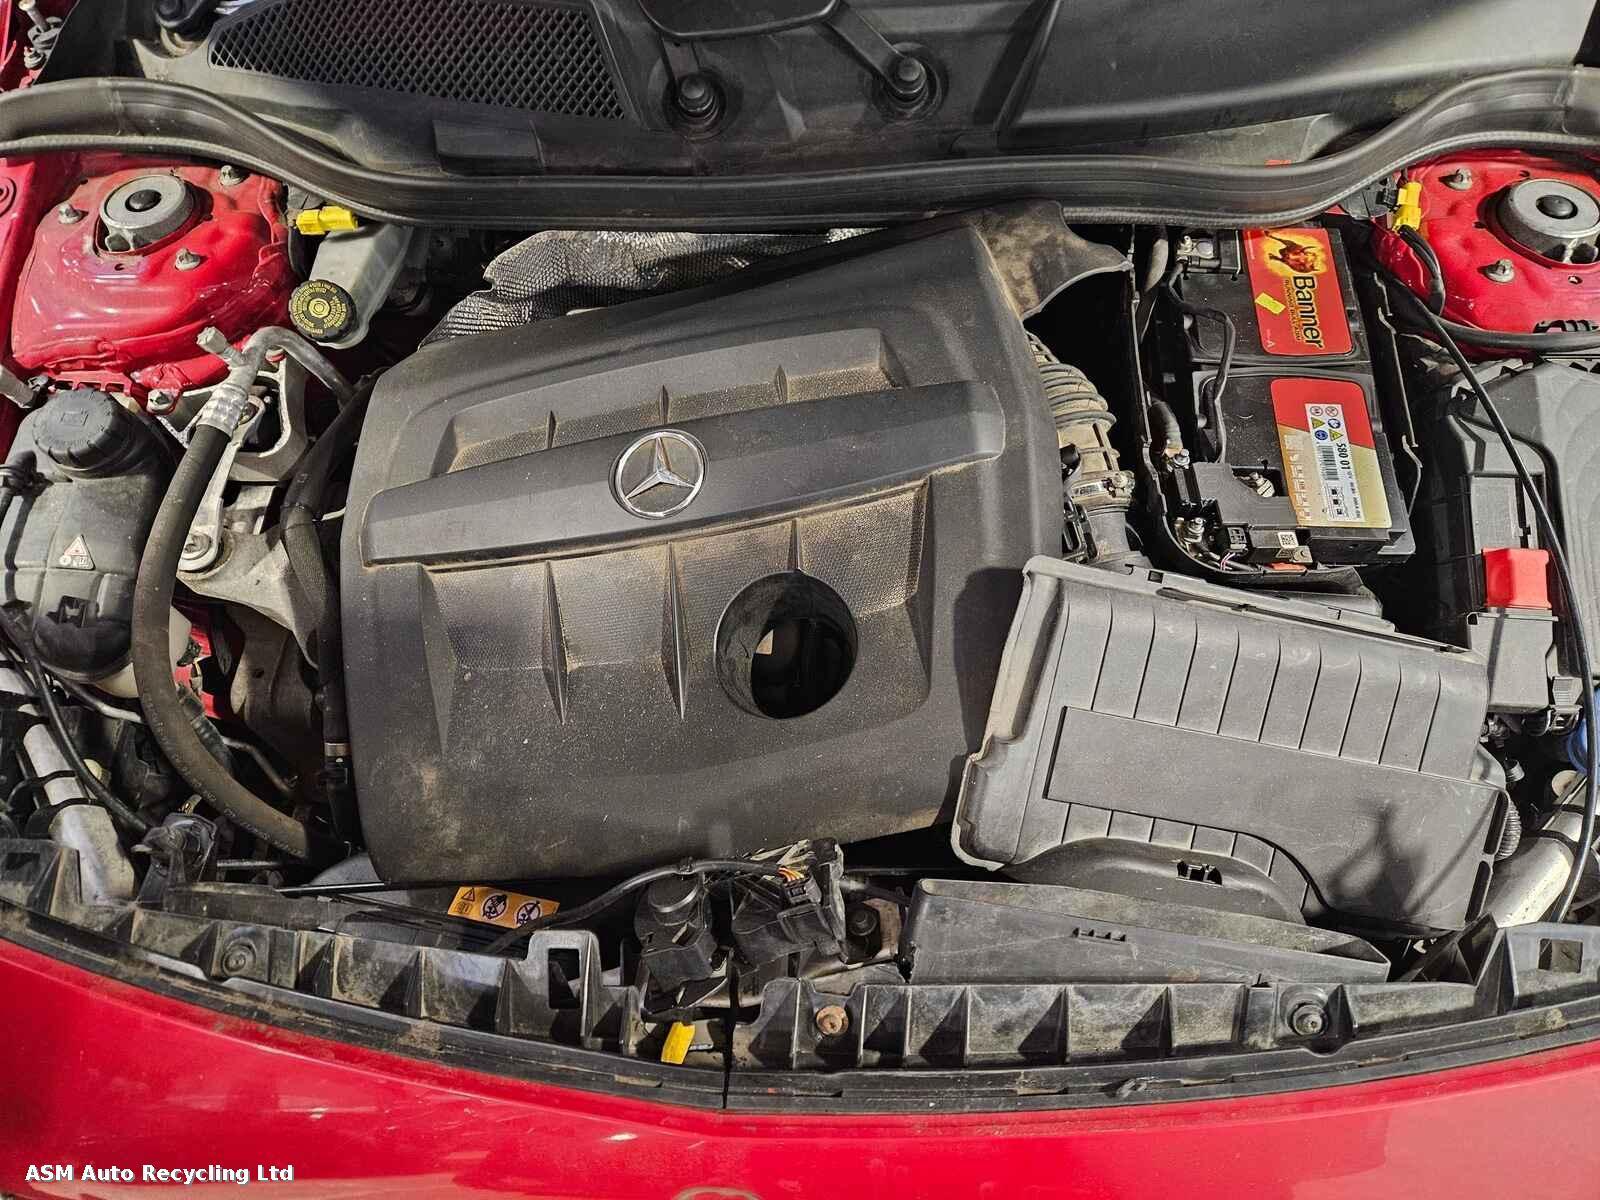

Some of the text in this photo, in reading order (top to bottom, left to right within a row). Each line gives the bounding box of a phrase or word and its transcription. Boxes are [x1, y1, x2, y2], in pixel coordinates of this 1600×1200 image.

[1292, 275, 1325, 349] Banner
[1336, 443, 1351, 470] 580 01
